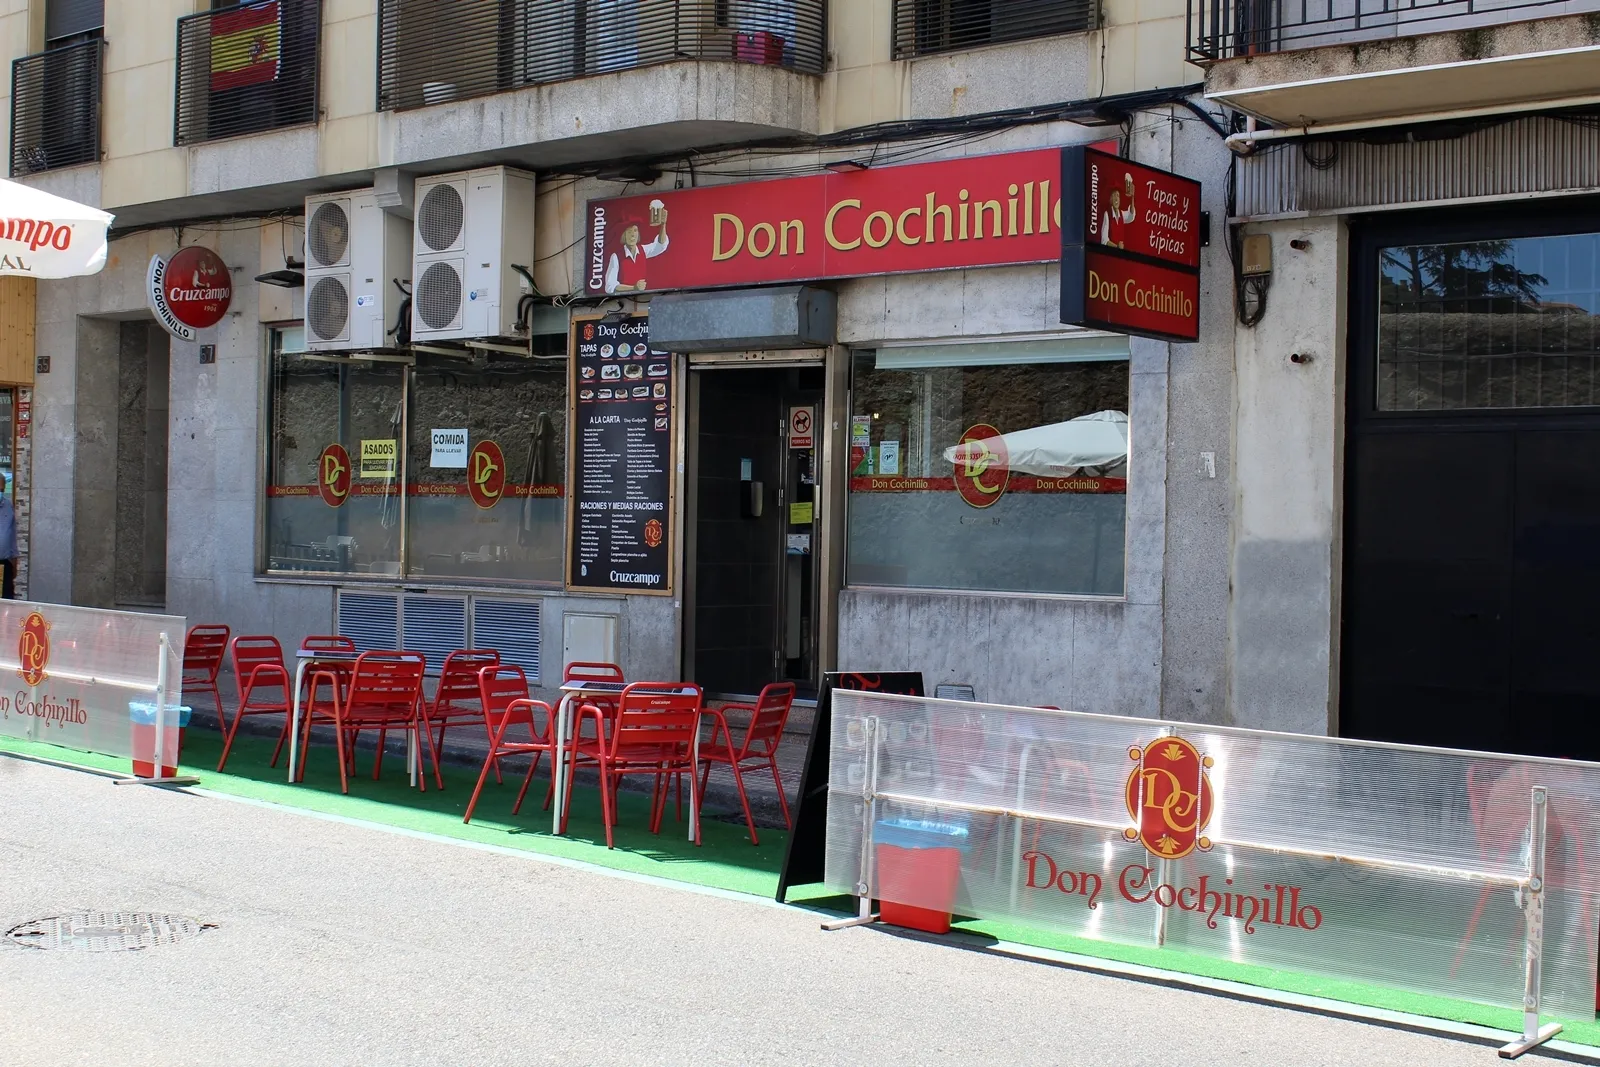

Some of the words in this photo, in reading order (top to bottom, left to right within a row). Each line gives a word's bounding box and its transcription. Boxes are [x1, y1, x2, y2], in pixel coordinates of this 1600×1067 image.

[1090, 164, 1099, 235] Cruzcampo
[1146, 180, 1178, 208] Tapas
[1182, 197, 1190, 215] y
[711, 212, 806, 263] Don
[825, 177, 1062, 251] Cochinill
[1145, 209, 1189, 233] comidas
[589, 206, 607, 290] Cruzcampo
[1149, 230, 1185, 255] típicas
[153, 260, 165, 284] DON
[170, 287, 230, 301] Cruzcampo
[1089, 270, 1119, 304] Don
[1124, 278, 1193, 318] Cochinillo
[153, 287, 189, 338] COCHINILLO
[597, 325, 617, 339] Don
[580, 343, 597, 353] TAPAS
[594, 416, 602, 424] LA
[602, 415, 621, 424] CARTA
[433, 434, 465, 445] COMIDA
[364, 443, 393, 455] ASADOS
[275, 486, 286, 494] Don
[286, 485, 310, 496] Cochinillo
[361, 485, 372, 494] Don
[418, 485, 429, 494] Don
[430, 485, 457, 495] Cochinillo
[515, 486, 528, 495] Don
[529, 486, 558, 495] Cochinillo
[871, 478, 888, 490] Don
[889, 477, 929, 490] Cochinillo
[1036, 479, 1054, 490] Don
[1056, 478, 1100, 491] Cochinillo
[580, 501, 608, 510] RACIONES
[608, 502, 613, 510] Y
[613, 502, 634, 510] MEDIAS
[634, 502, 664, 511] RACIONES
[609, 570, 660, 586] Cruzcampo
[14, 690, 87, 728] Cochinillo
[1023, 851, 1103, 910] Don
[1118, 863, 1323, 936] Cochinillo
